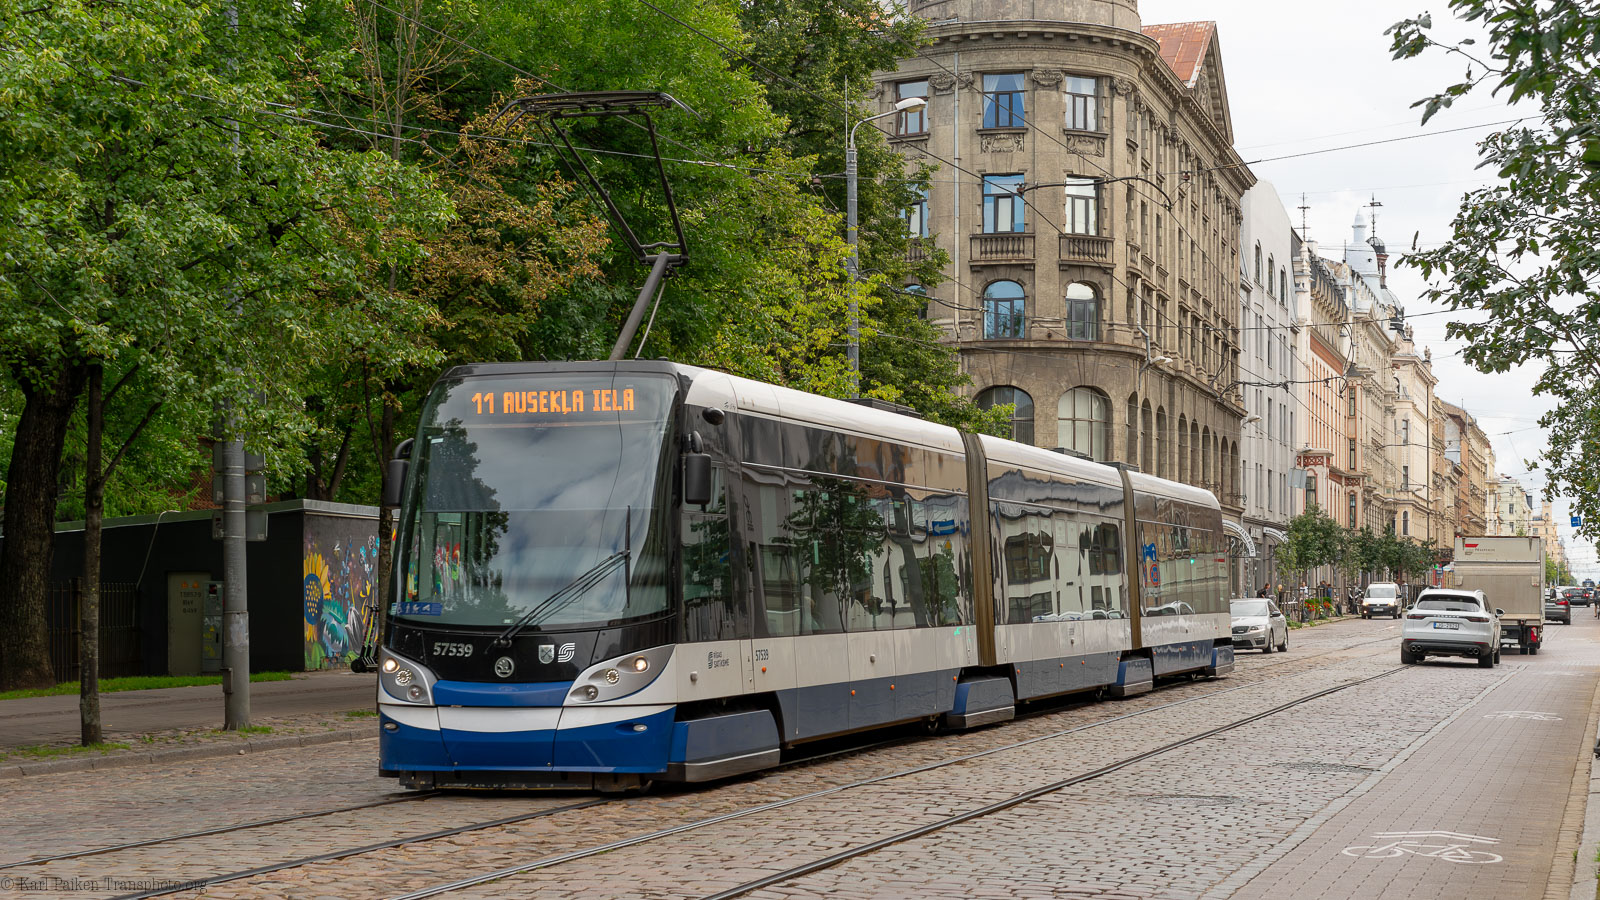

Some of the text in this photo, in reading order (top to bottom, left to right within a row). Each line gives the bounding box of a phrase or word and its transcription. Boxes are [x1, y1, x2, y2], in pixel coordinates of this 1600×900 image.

[472, 388, 634, 414] 11 AUSEKĻA IELA
[433, 642, 473, 657] 57539
[755, 649, 769, 661] 57539
